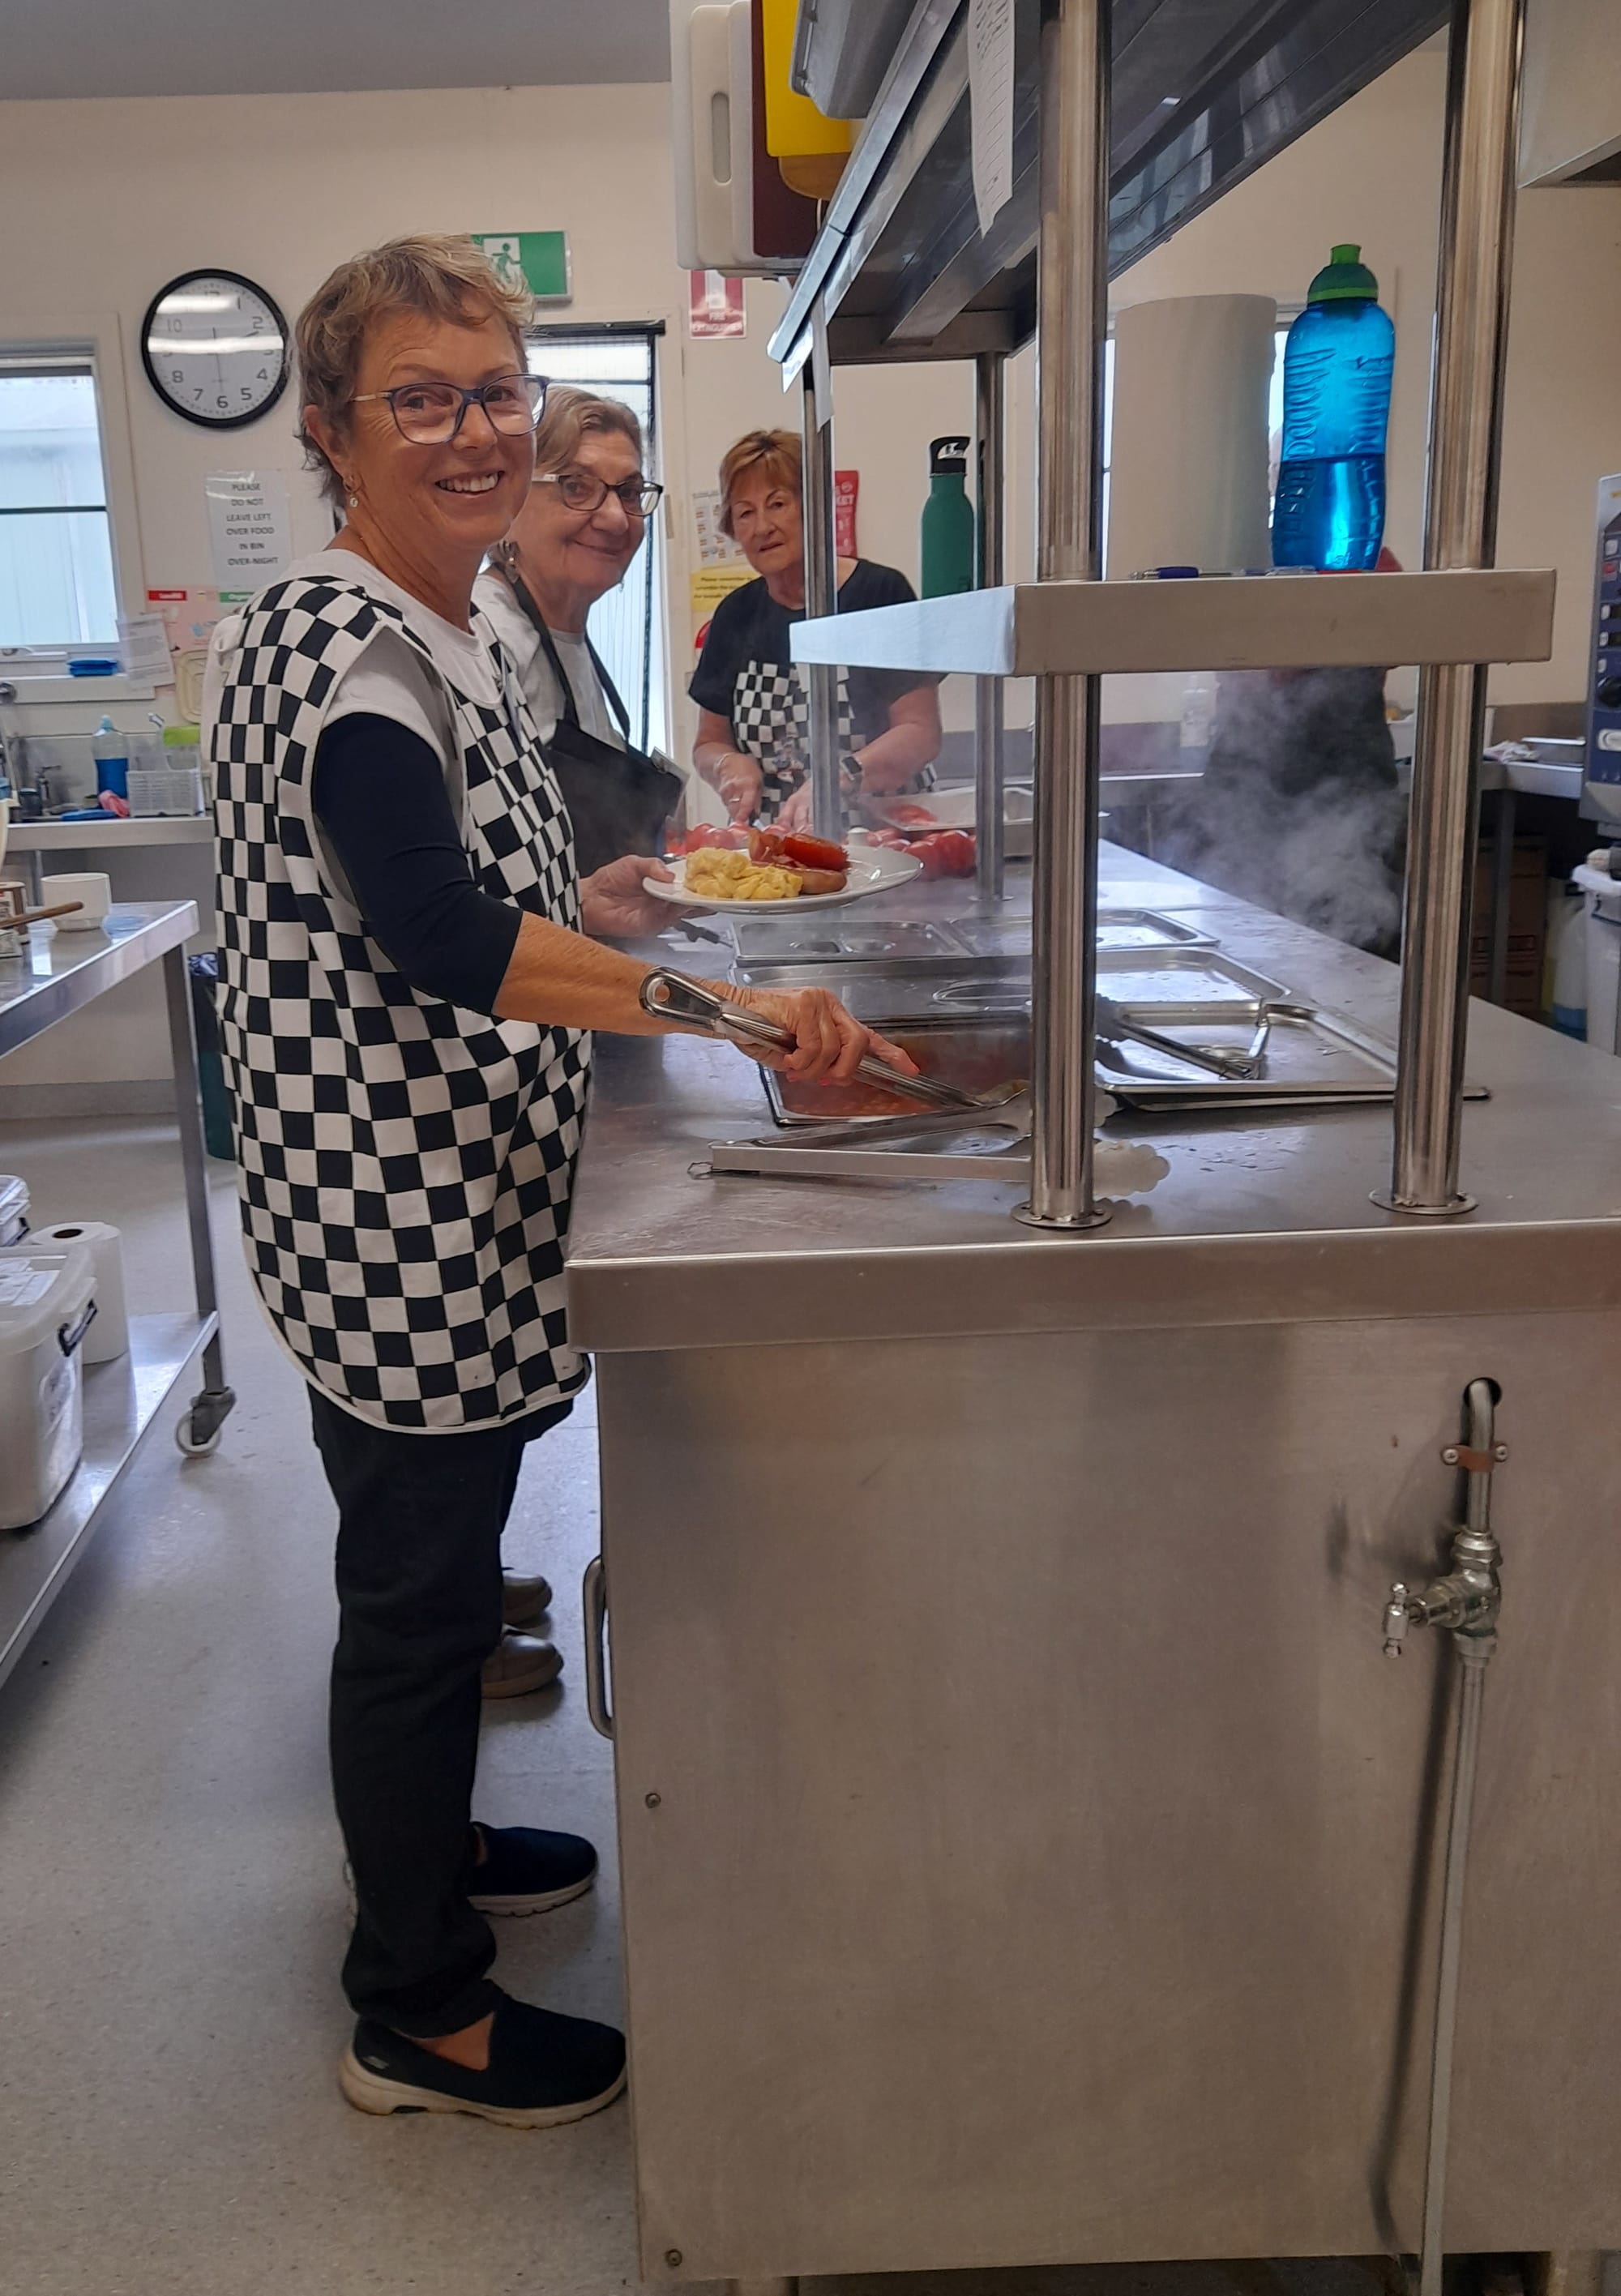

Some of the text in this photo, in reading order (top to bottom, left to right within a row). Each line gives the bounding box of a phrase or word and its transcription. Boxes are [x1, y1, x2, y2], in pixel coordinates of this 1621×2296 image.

[166, 319, 182, 332] 10
[252, 316, 263, 329] 2
[172, 370, 184, 383] 8
[256, 368, 268, 380] 4
[193, 388, 204, 401] 7
[240, 387, 252, 400] 5
[216, 395, 229, 408] 6
[232, 483, 260, 491] PLEASE
[231, 498, 263, 507] DO NOT
[226, 513, 272, 522] LEAVE LEFT
[227, 556, 278, 566] OVER-NIGHT
